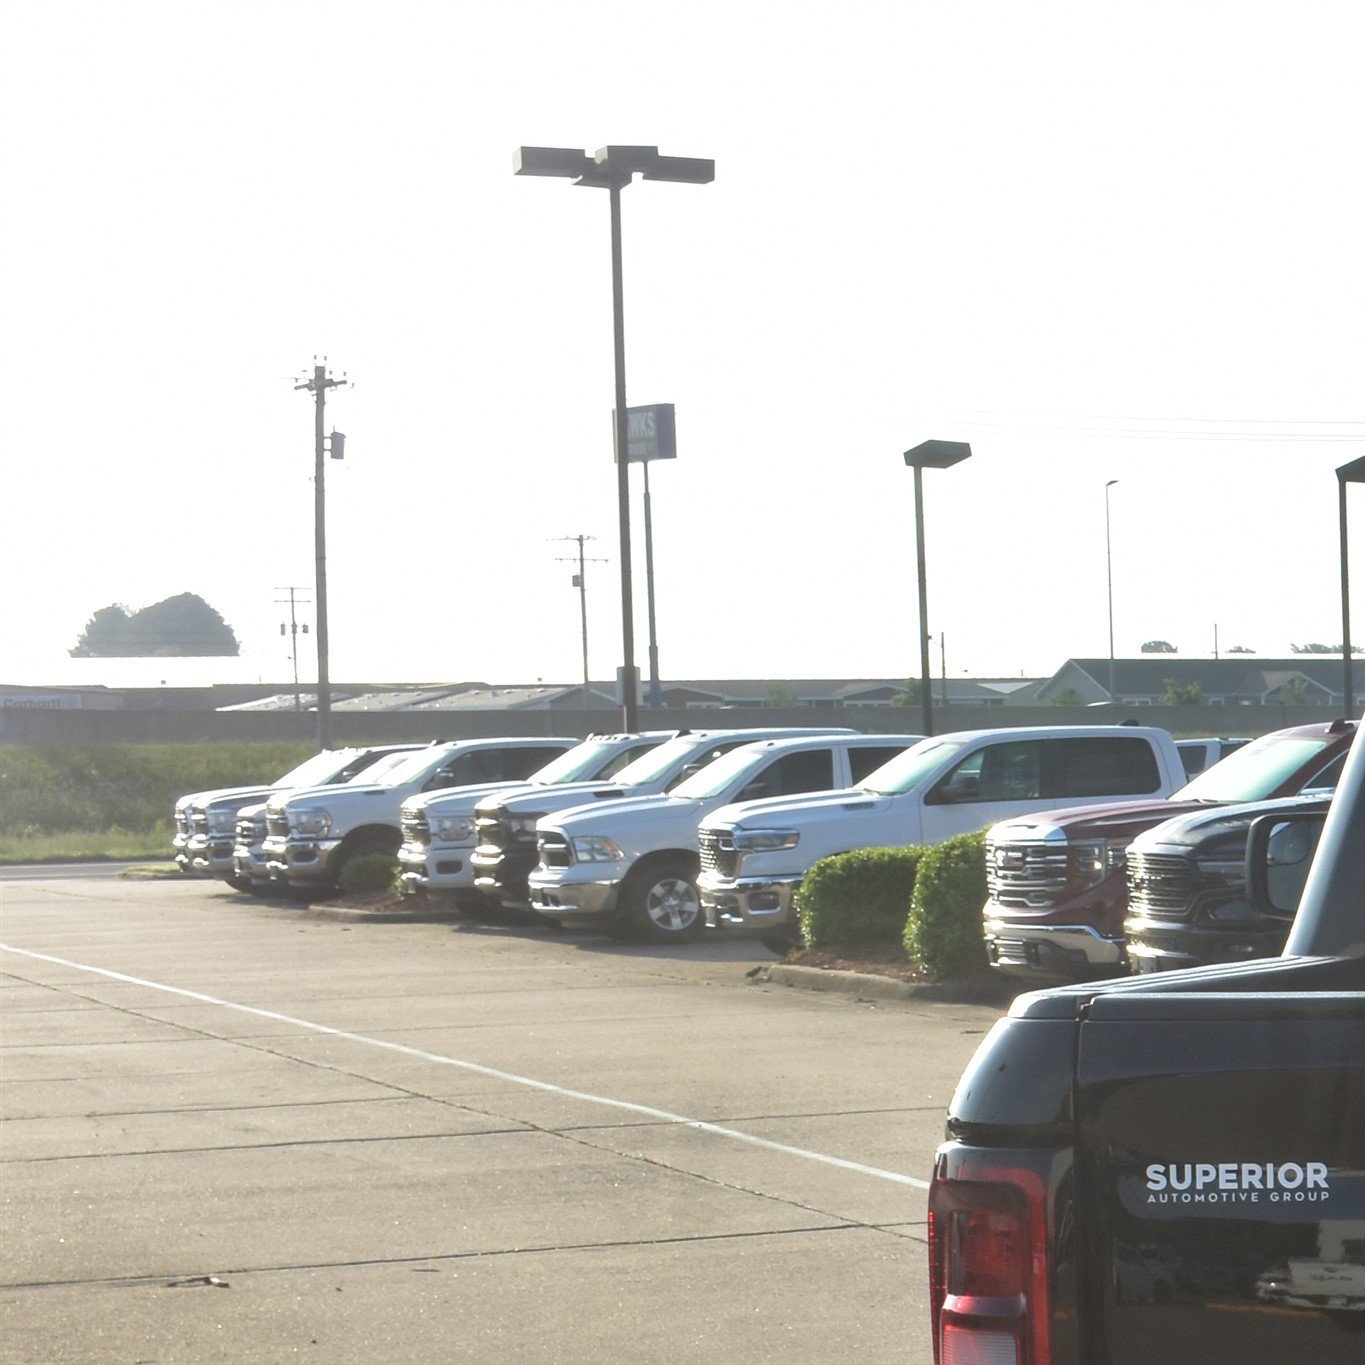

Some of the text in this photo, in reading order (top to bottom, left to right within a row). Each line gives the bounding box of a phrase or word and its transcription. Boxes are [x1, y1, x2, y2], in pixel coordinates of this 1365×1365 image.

[1146, 1162, 1330, 1191] SUPERIOR
[1147, 1191, 1330, 1204] AUTOMOTIVE GROUP
